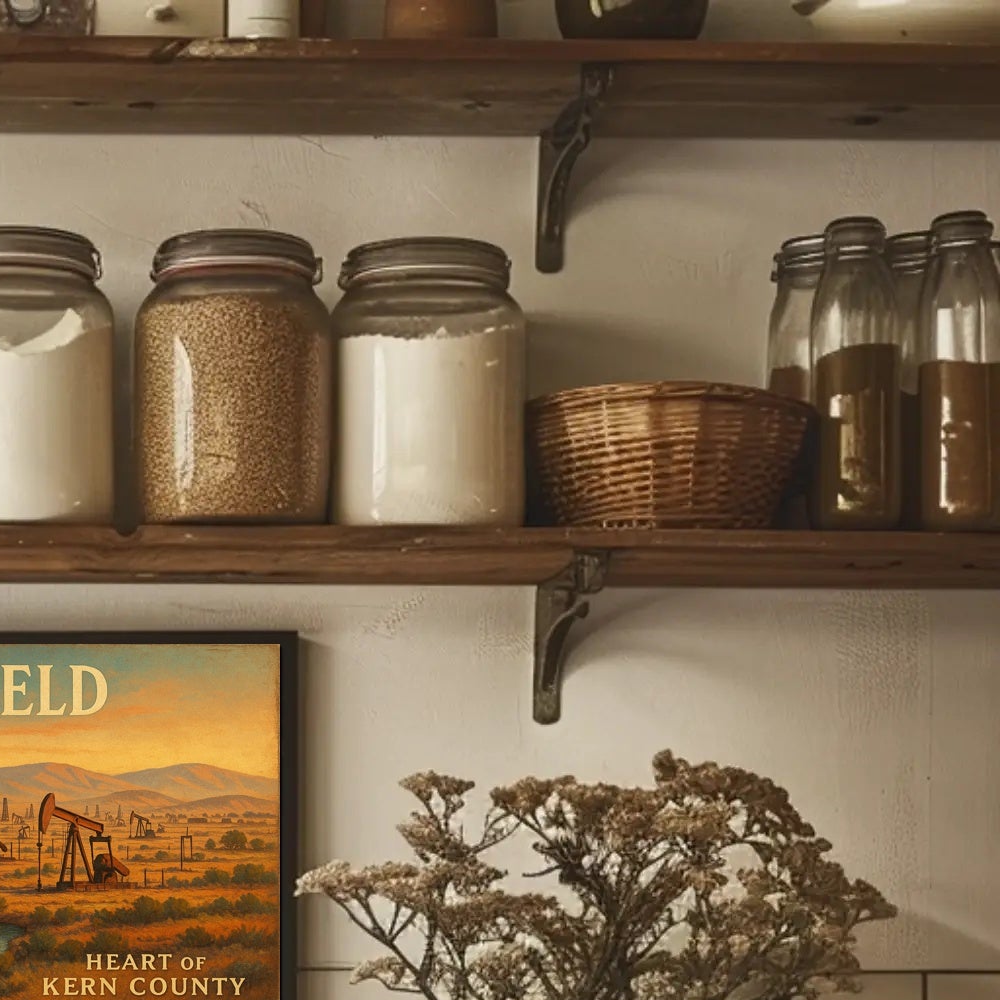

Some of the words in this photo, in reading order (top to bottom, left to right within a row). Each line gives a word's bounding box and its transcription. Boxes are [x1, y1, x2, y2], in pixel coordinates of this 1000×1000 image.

[86, 953, 172, 971] HEART
[180, 956, 206, 971] OF
[42, 977, 118, 996] KERN
[129, 977, 246, 996] COUNTY
